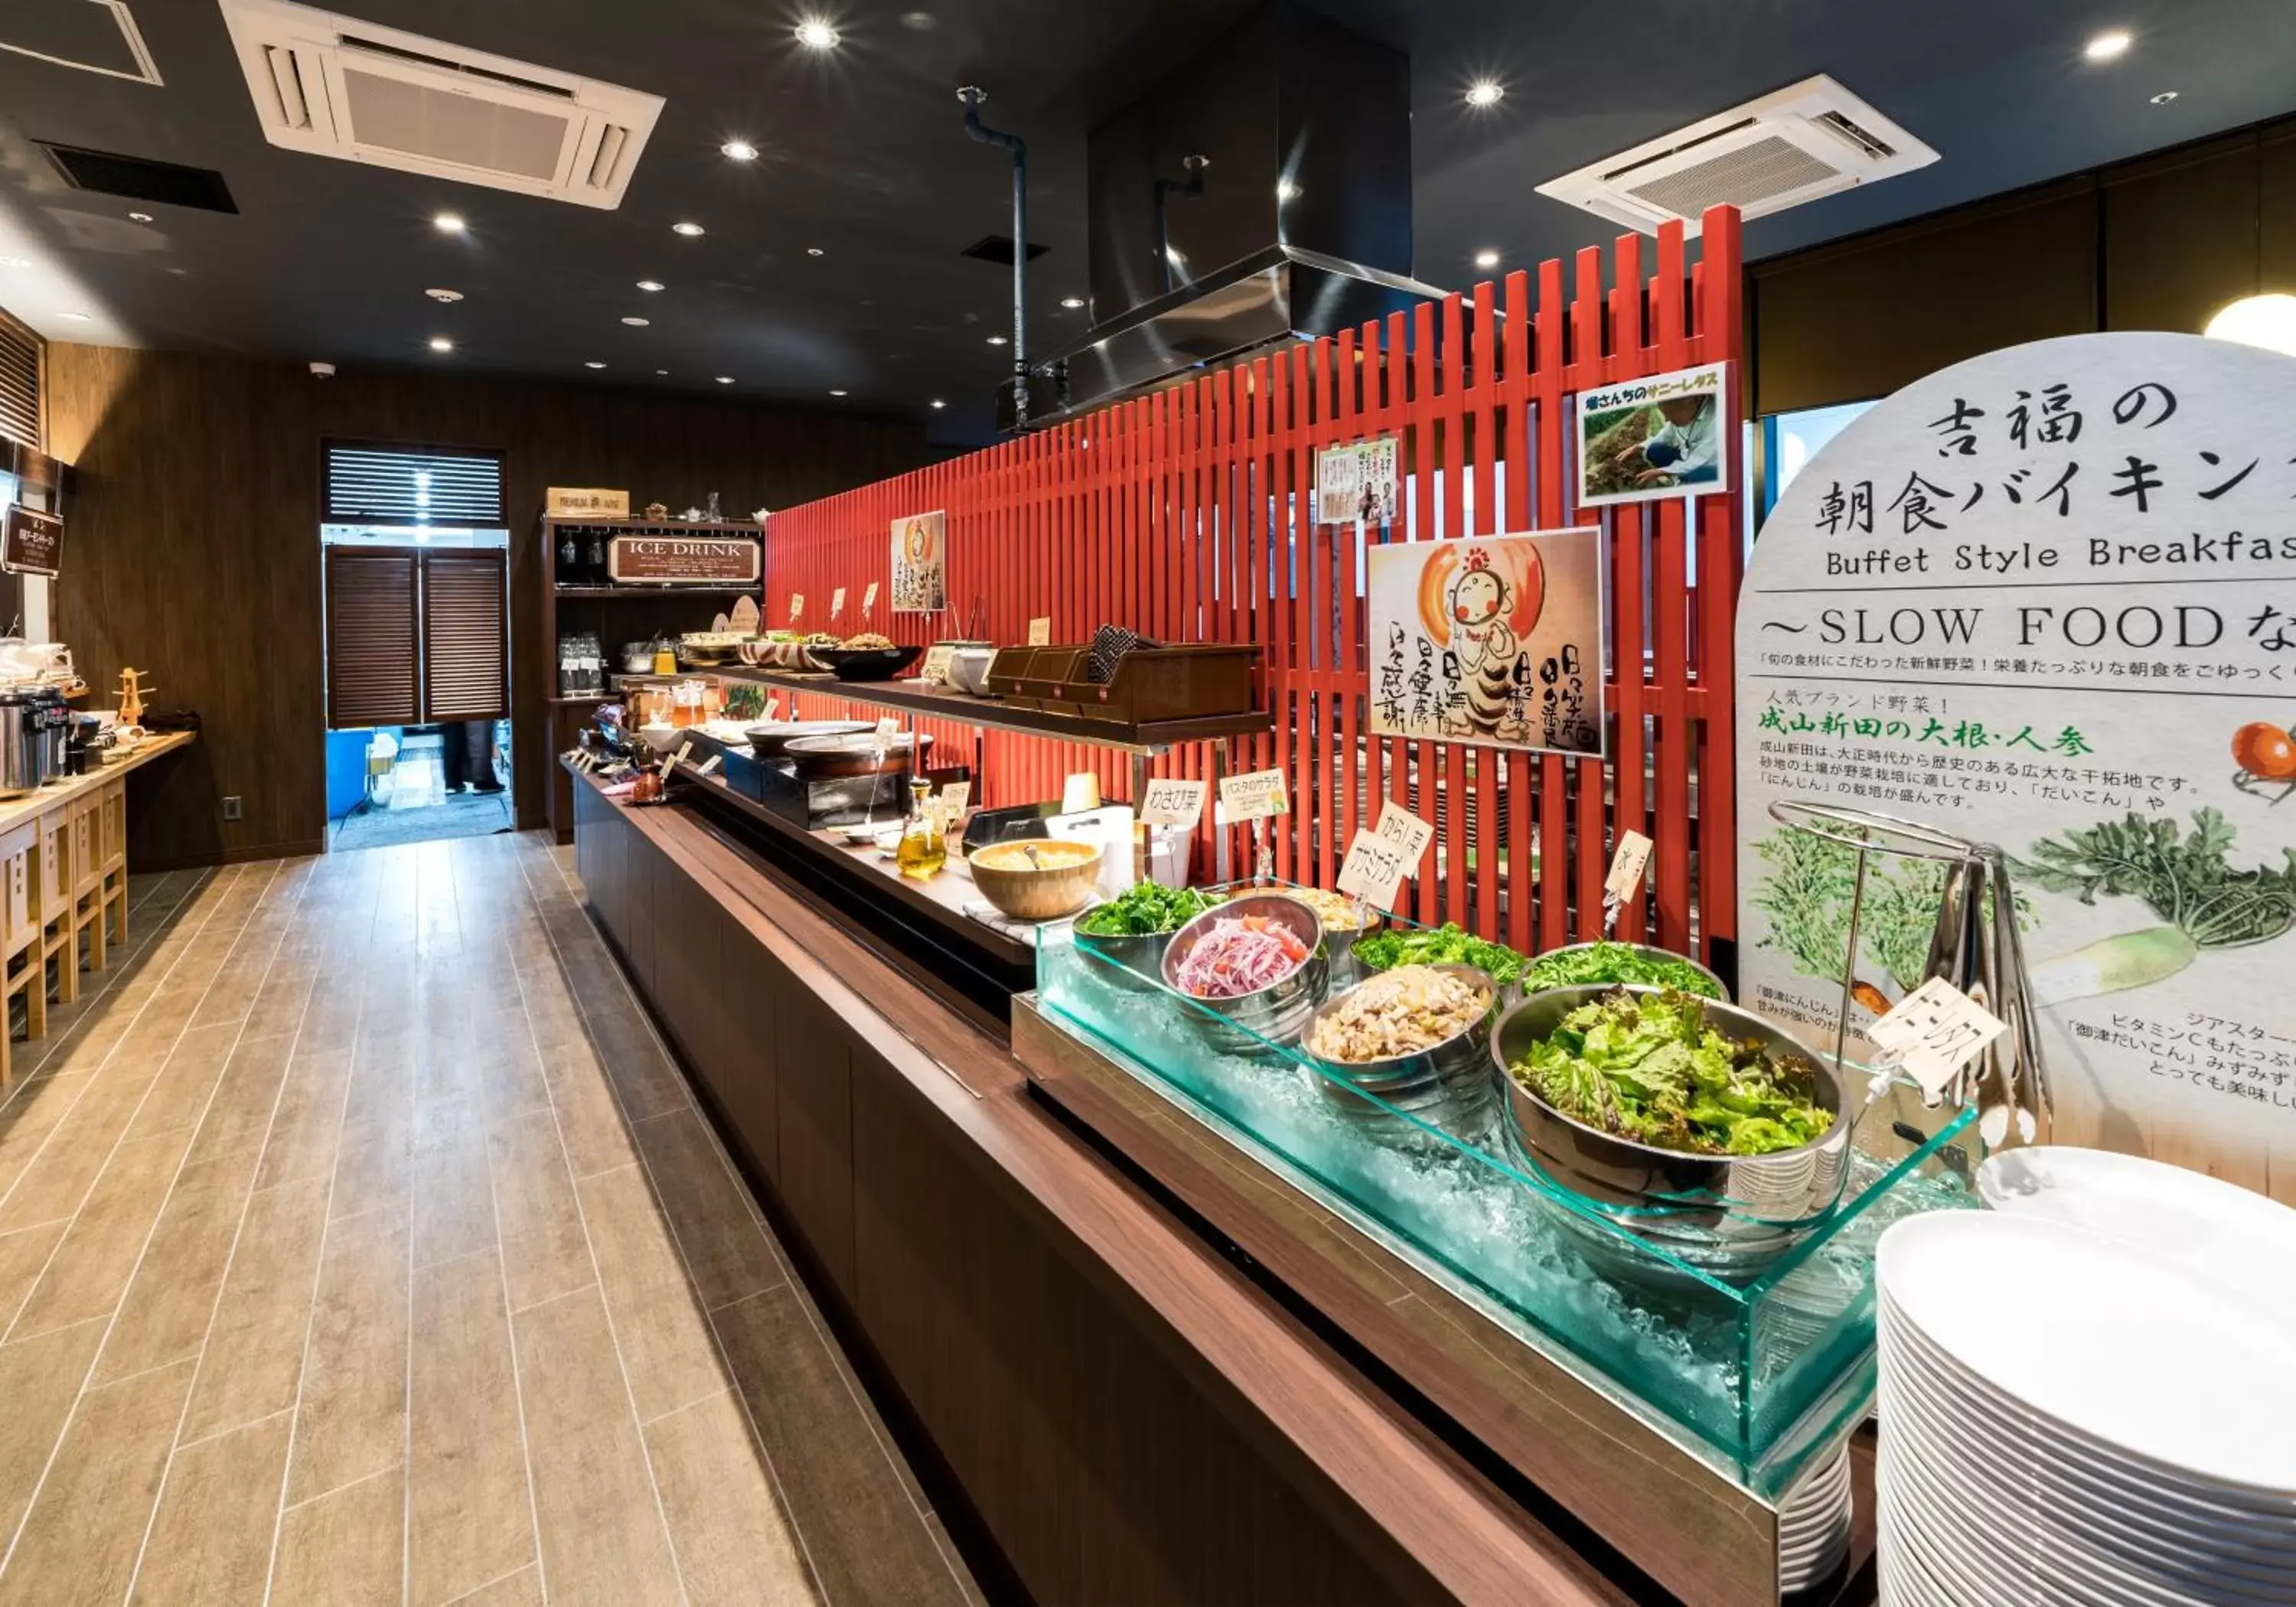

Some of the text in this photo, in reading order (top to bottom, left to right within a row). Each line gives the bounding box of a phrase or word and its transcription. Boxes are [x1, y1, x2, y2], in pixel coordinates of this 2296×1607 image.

[1927, 383, 2178, 458] 吉福の
[1815, 450, 2296, 536] 朝食バイキン
[630, 542, 742, 556] ICE DRINK
[1827, 531, 2296, 575] Buffet Style Breakfas
[2017, 605, 2224, 648] FOOD
[1760, 652, 2296, 680] 「旬の食材にこだわった新鮮野菜！栄養たっぷりな朝食をごゆっく
[2112, 1013, 2296, 1068] ビタミンCもたっぷ
[2186, 1012, 2296, 1044] ジアスター
[2067, 1020, 2296, 1086] 「御津だいこん」みずみず
